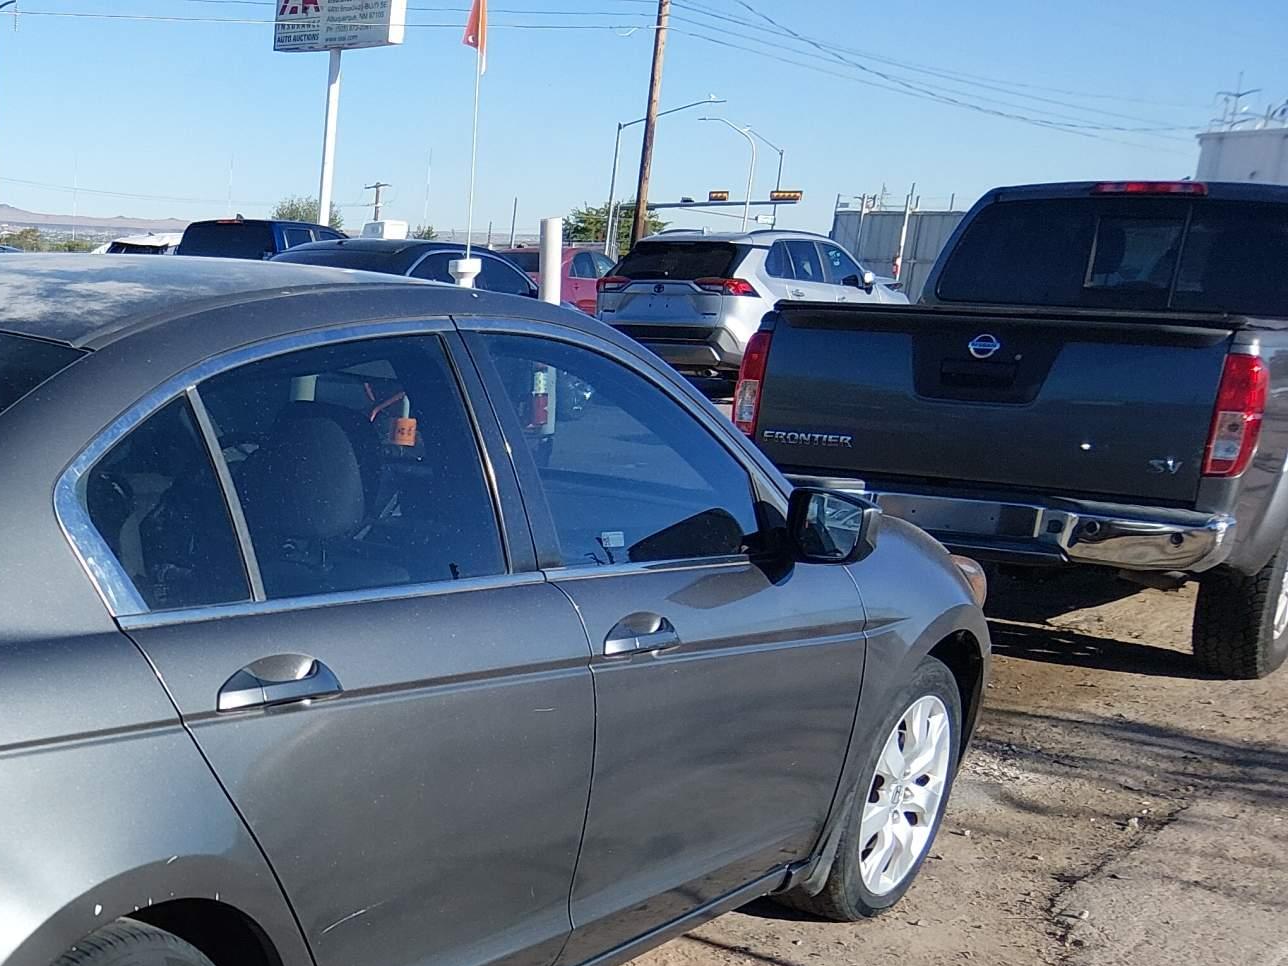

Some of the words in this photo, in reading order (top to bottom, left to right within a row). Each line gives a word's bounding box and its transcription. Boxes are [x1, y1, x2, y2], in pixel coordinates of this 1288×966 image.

[277, 35, 292, 43] AUTO
[293, 33, 320, 42] AUCTIONS
[763, 430, 853, 448] FRONTIER
[1146, 459, 1184, 474] SV
